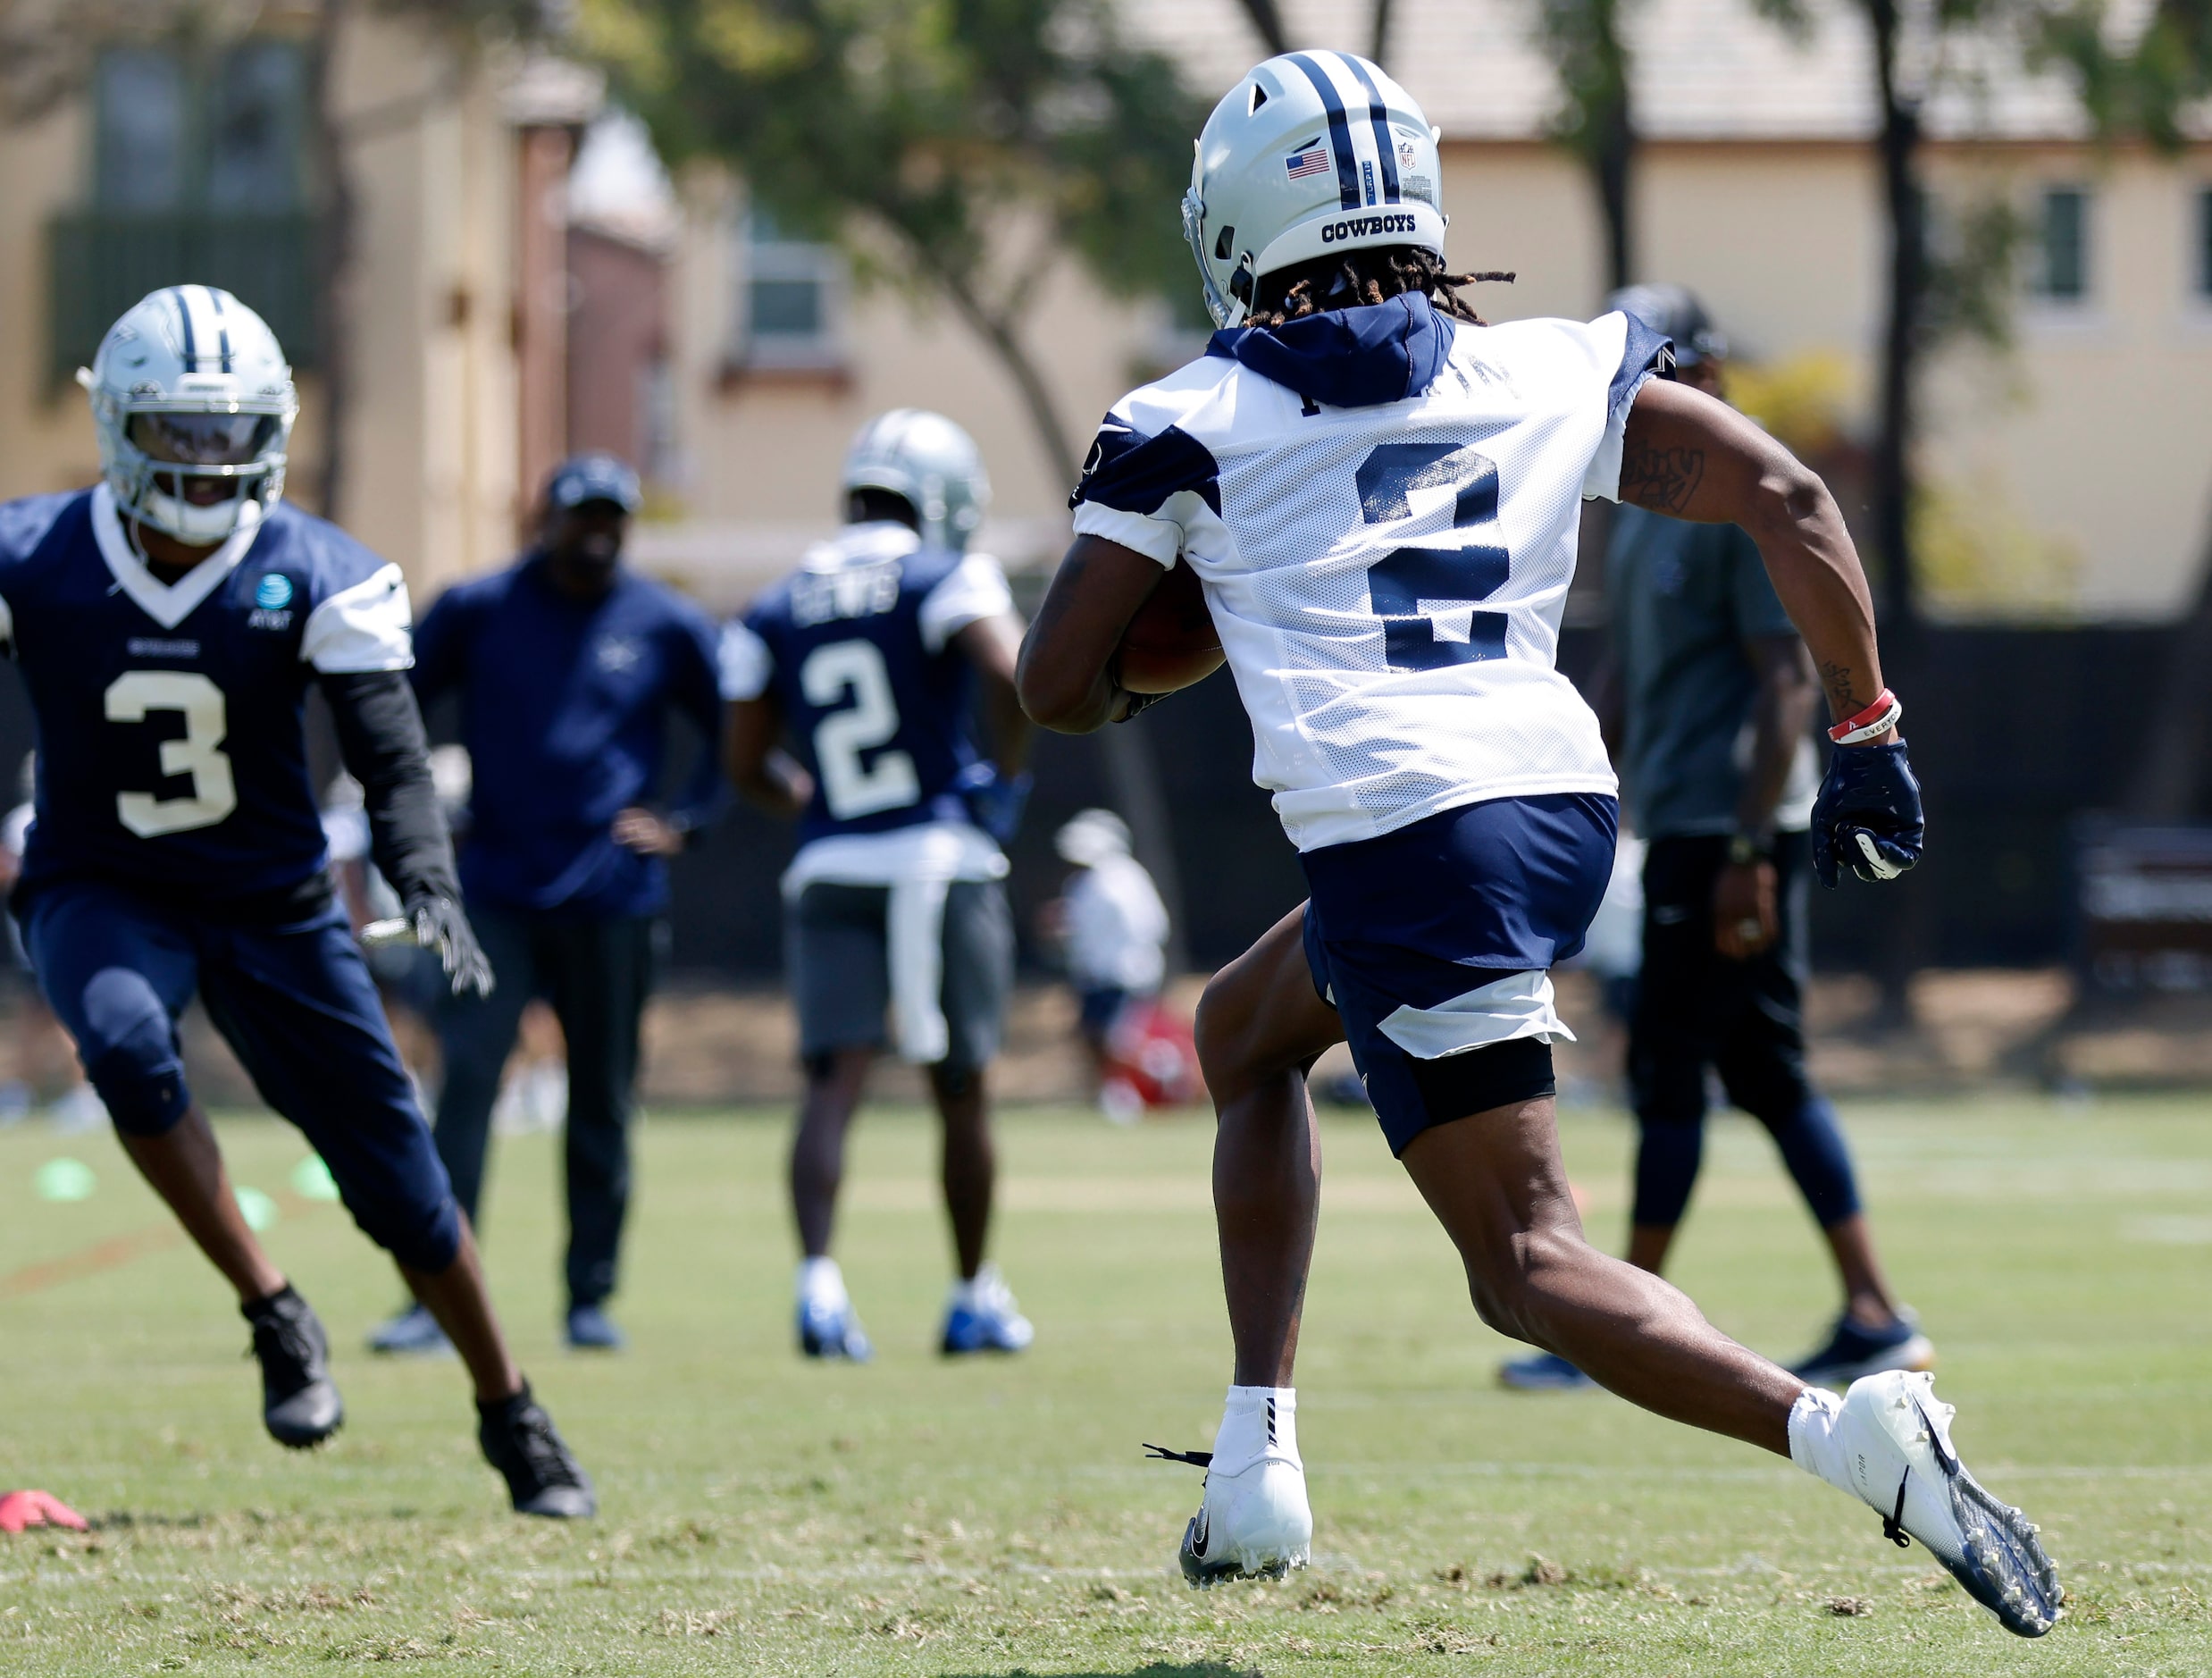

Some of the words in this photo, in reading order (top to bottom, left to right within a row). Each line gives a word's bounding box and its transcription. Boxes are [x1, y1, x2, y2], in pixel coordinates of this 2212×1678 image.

[1322, 214, 1415, 242] COWBOYS
[1401, 153, 1415, 167] NFL
[1356, 443, 1510, 674] 2
[105, 670, 238, 838] 3
[800, 638, 921, 820] 2
